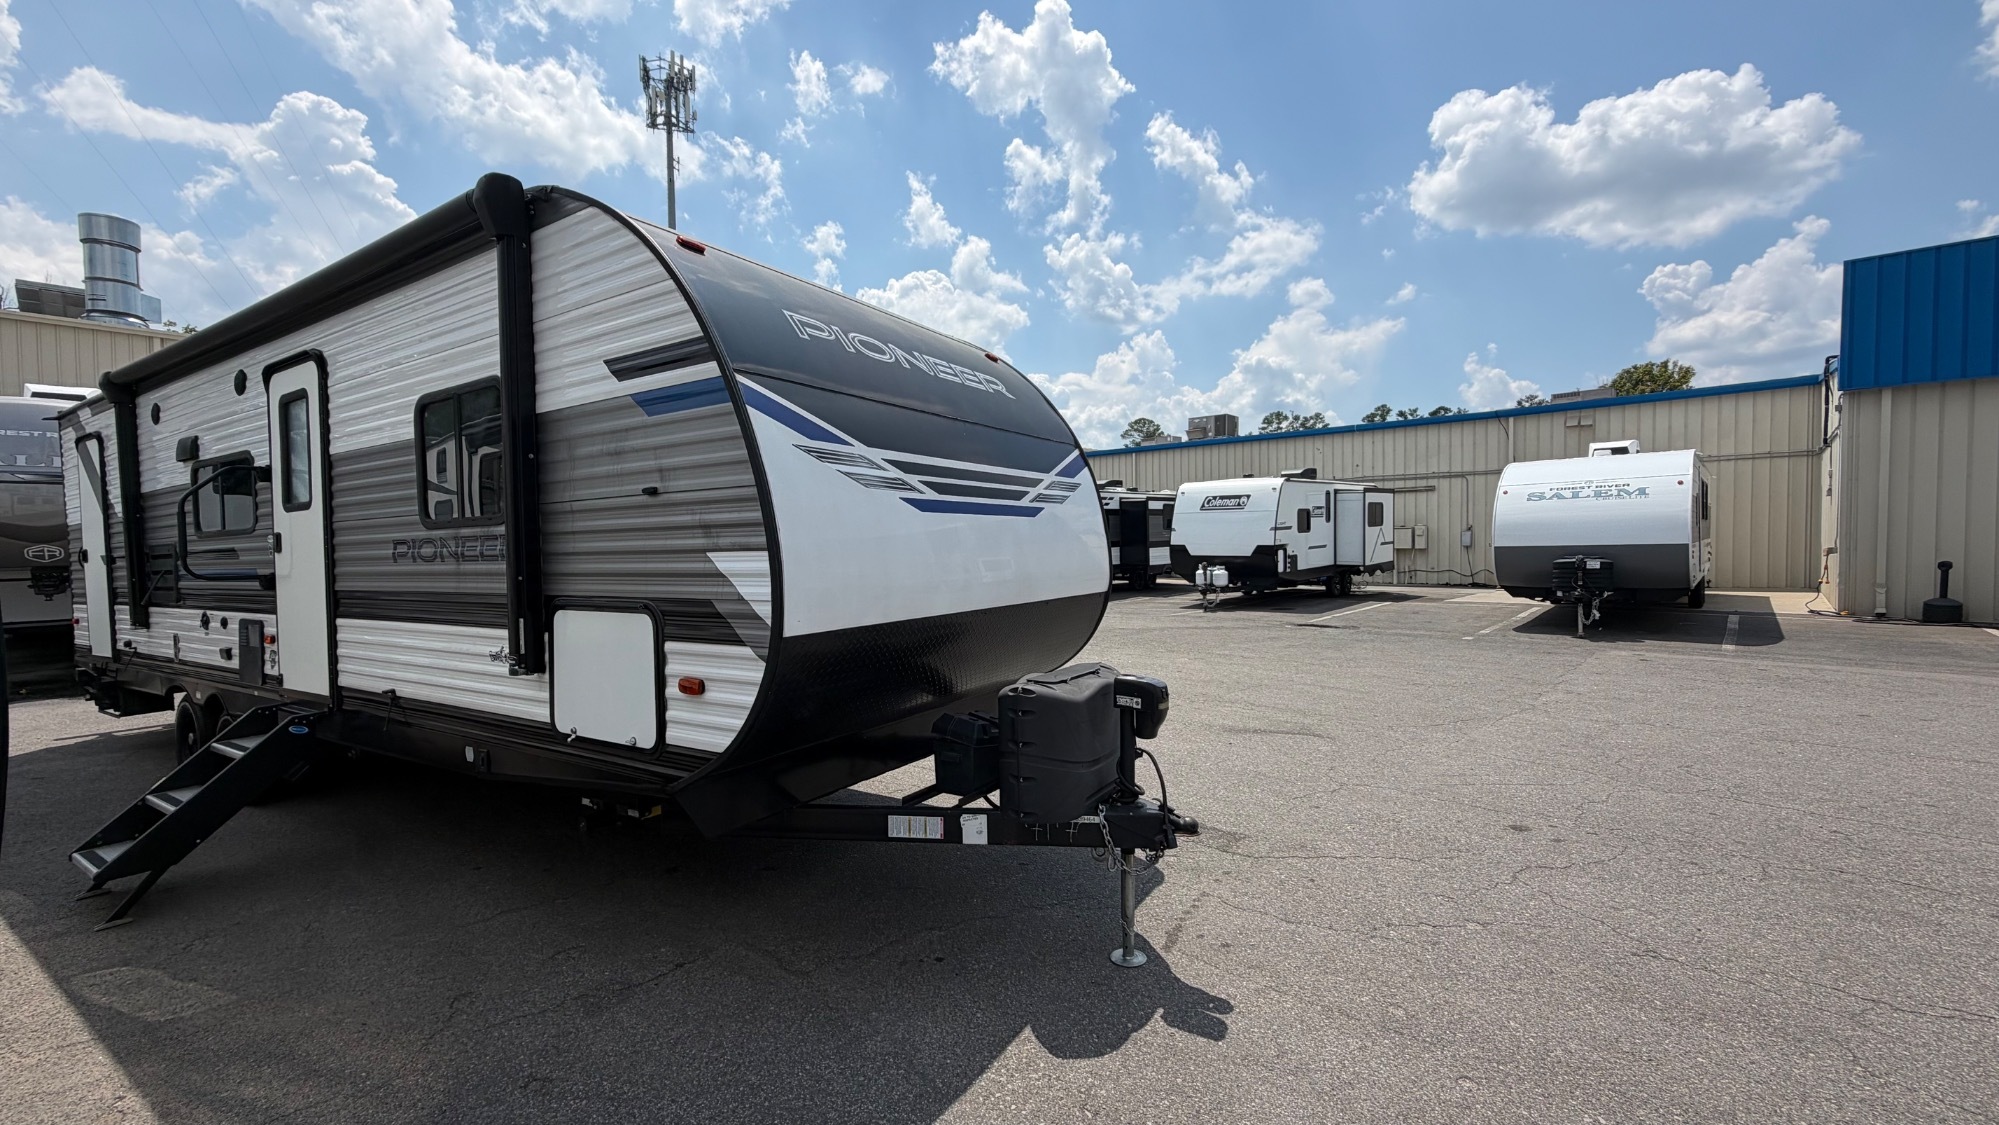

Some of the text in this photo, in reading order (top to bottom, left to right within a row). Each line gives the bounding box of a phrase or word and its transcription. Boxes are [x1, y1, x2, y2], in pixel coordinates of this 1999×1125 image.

[781, 308, 1017, 400] PIONEER
[1526, 486, 1650, 502] SALEM
[1549, 484, 1592, 492] FOREST
[1204, 496, 1240, 507] Coleman
[391, 534, 506, 563] PIONEE
